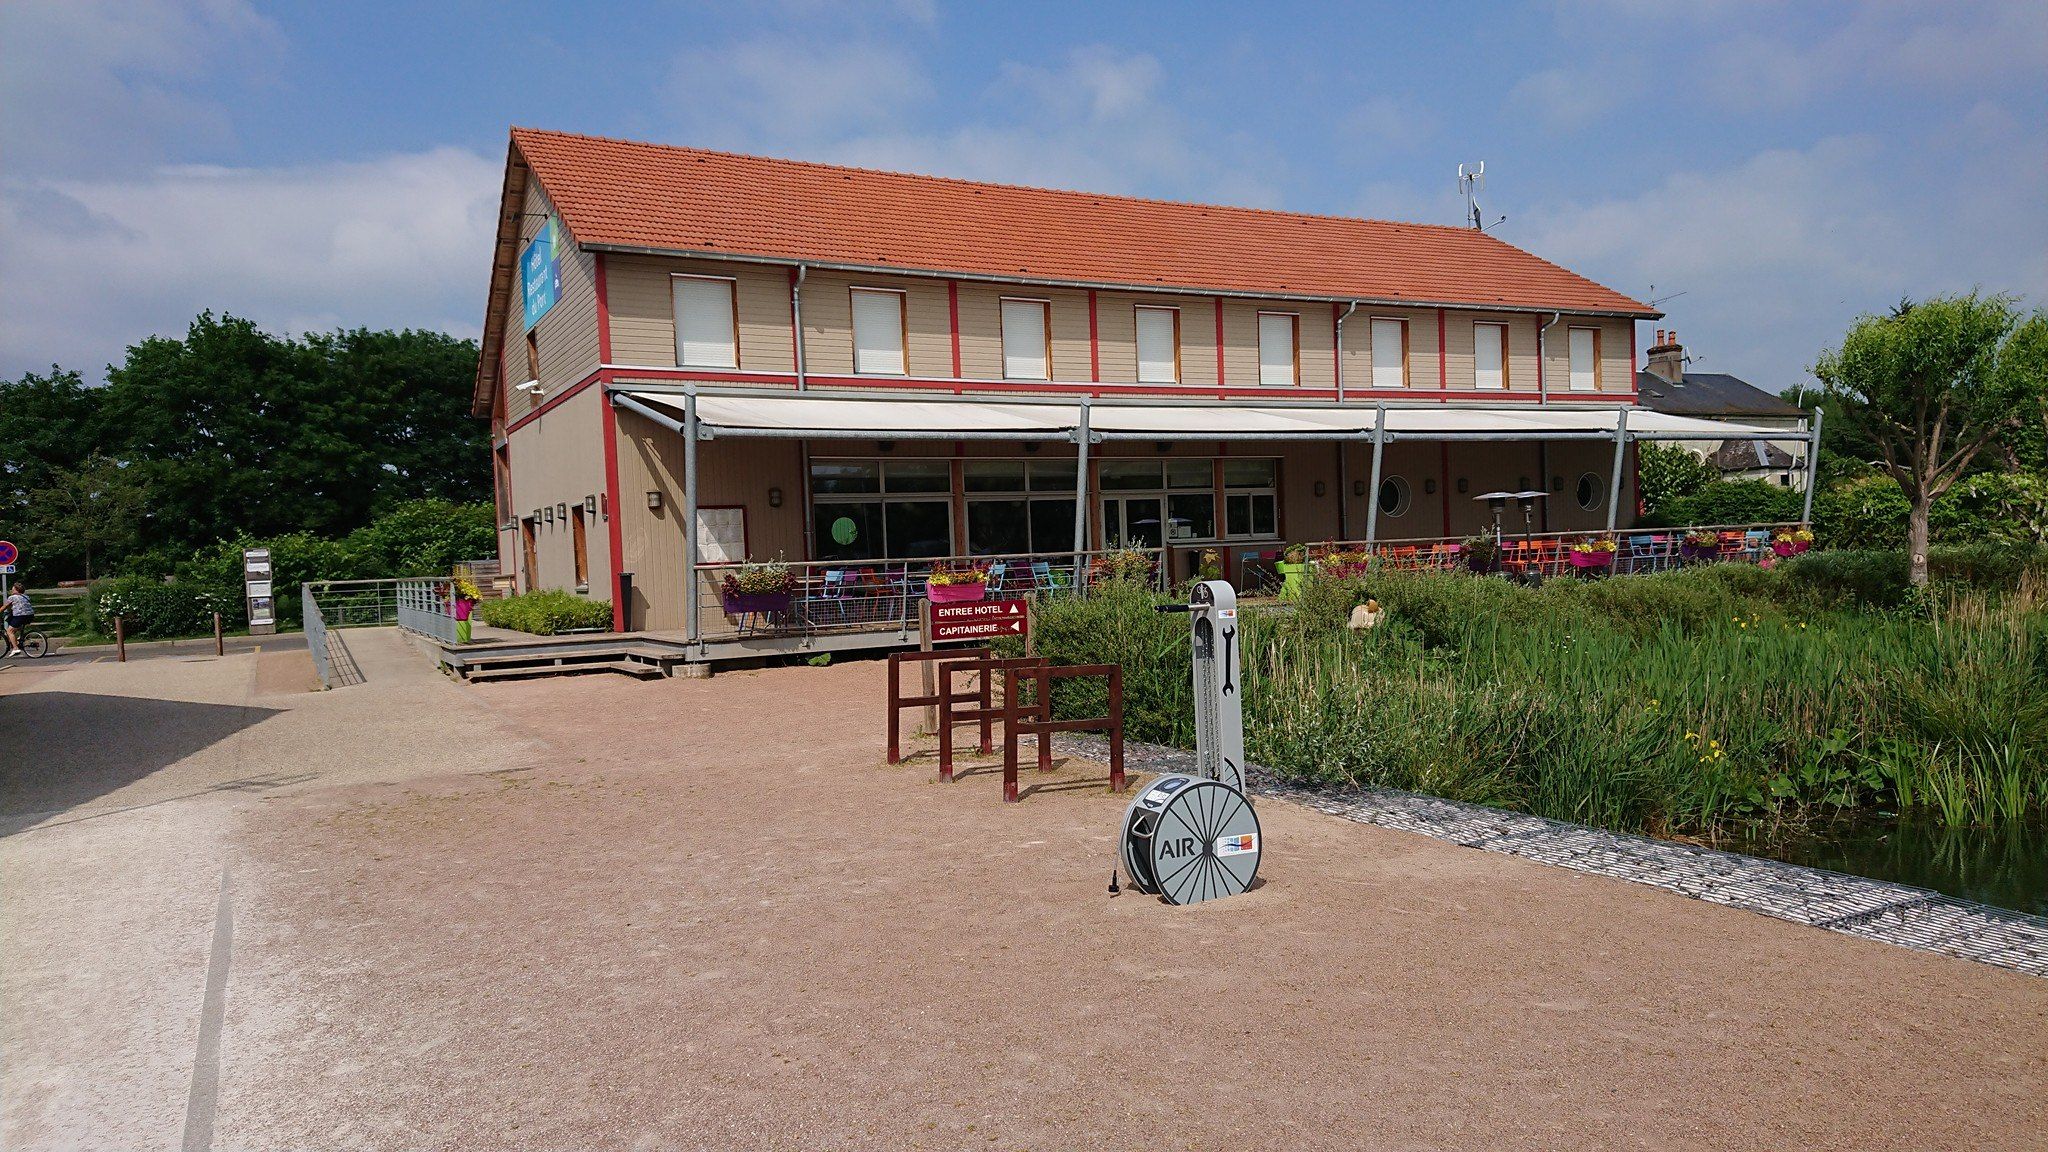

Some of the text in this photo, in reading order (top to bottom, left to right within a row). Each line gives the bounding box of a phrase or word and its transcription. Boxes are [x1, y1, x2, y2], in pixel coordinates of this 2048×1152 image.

[527, 265, 548, 297] Restaurant
[938, 605, 1003, 617] ENTREE HOTEL
[939, 623, 998, 636] CAPITAINERIE
[1159, 837, 1196, 860] AIR
